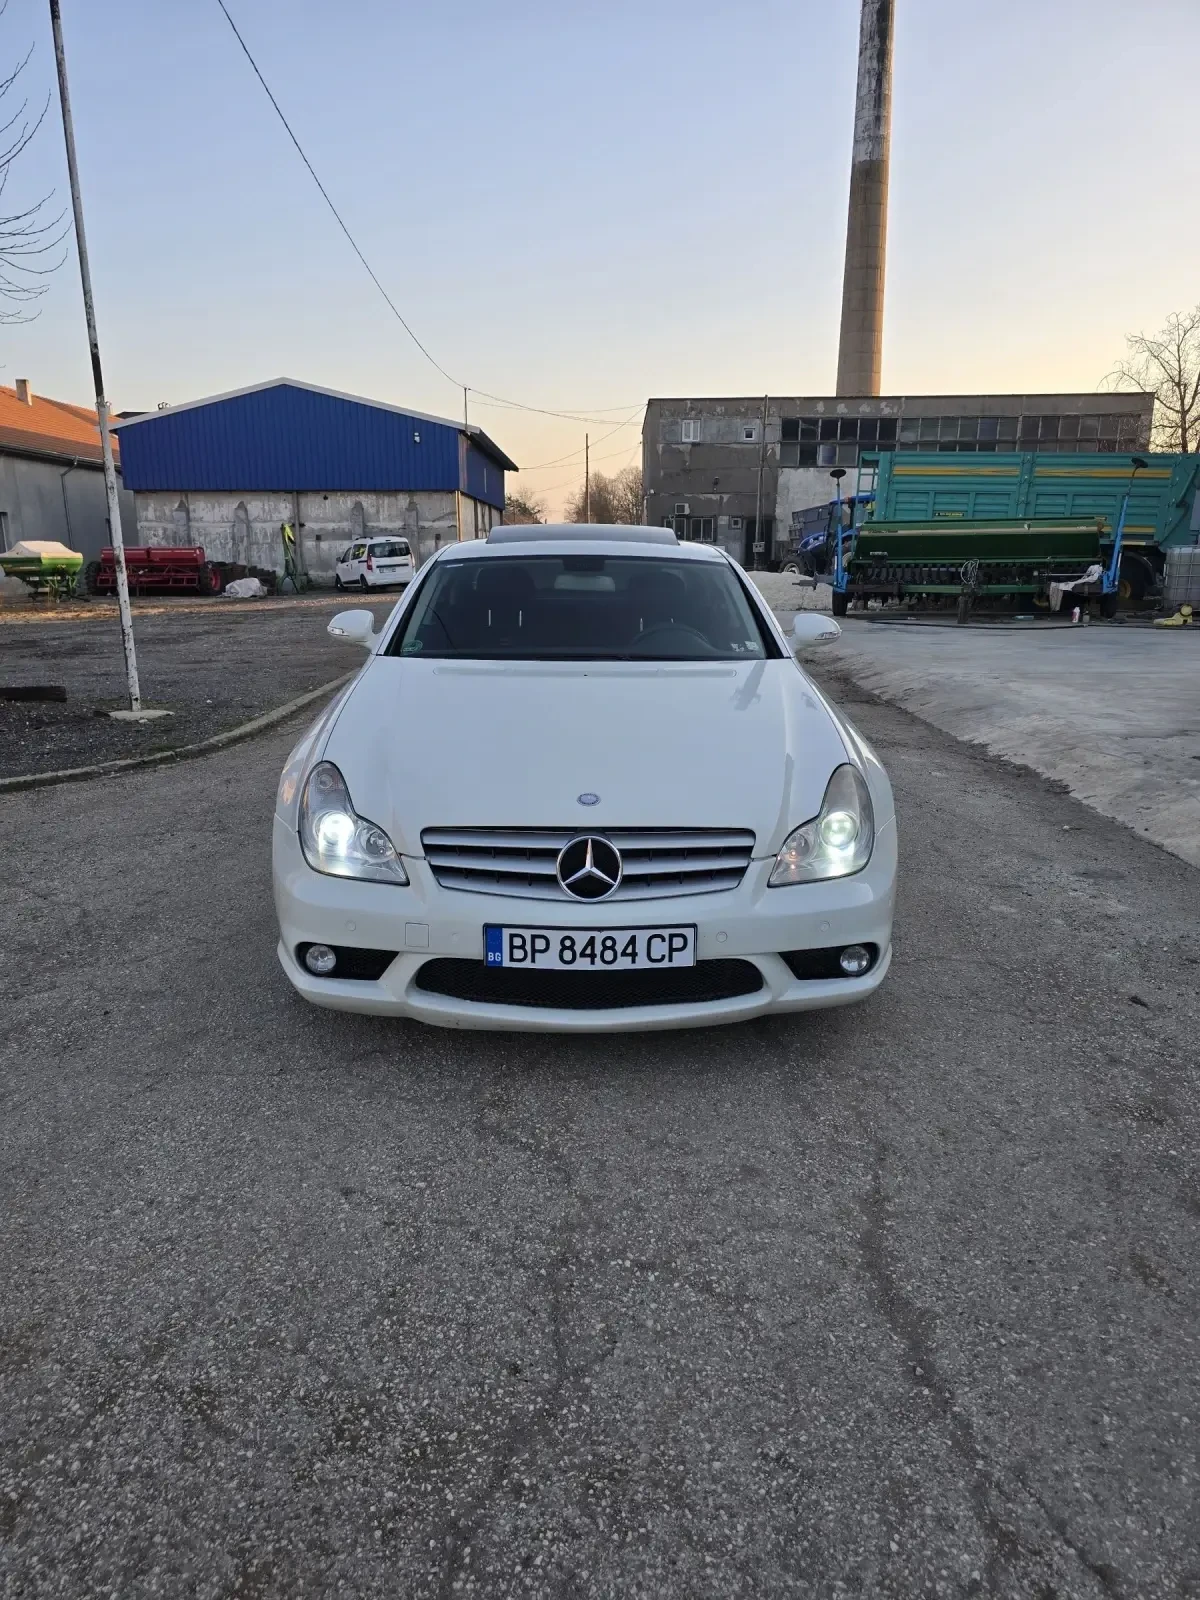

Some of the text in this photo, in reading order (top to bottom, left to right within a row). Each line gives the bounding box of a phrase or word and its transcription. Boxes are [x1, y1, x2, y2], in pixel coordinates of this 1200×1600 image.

[488, 952, 502, 962] BG
[509, 933, 688, 965] BP 8484 CP
